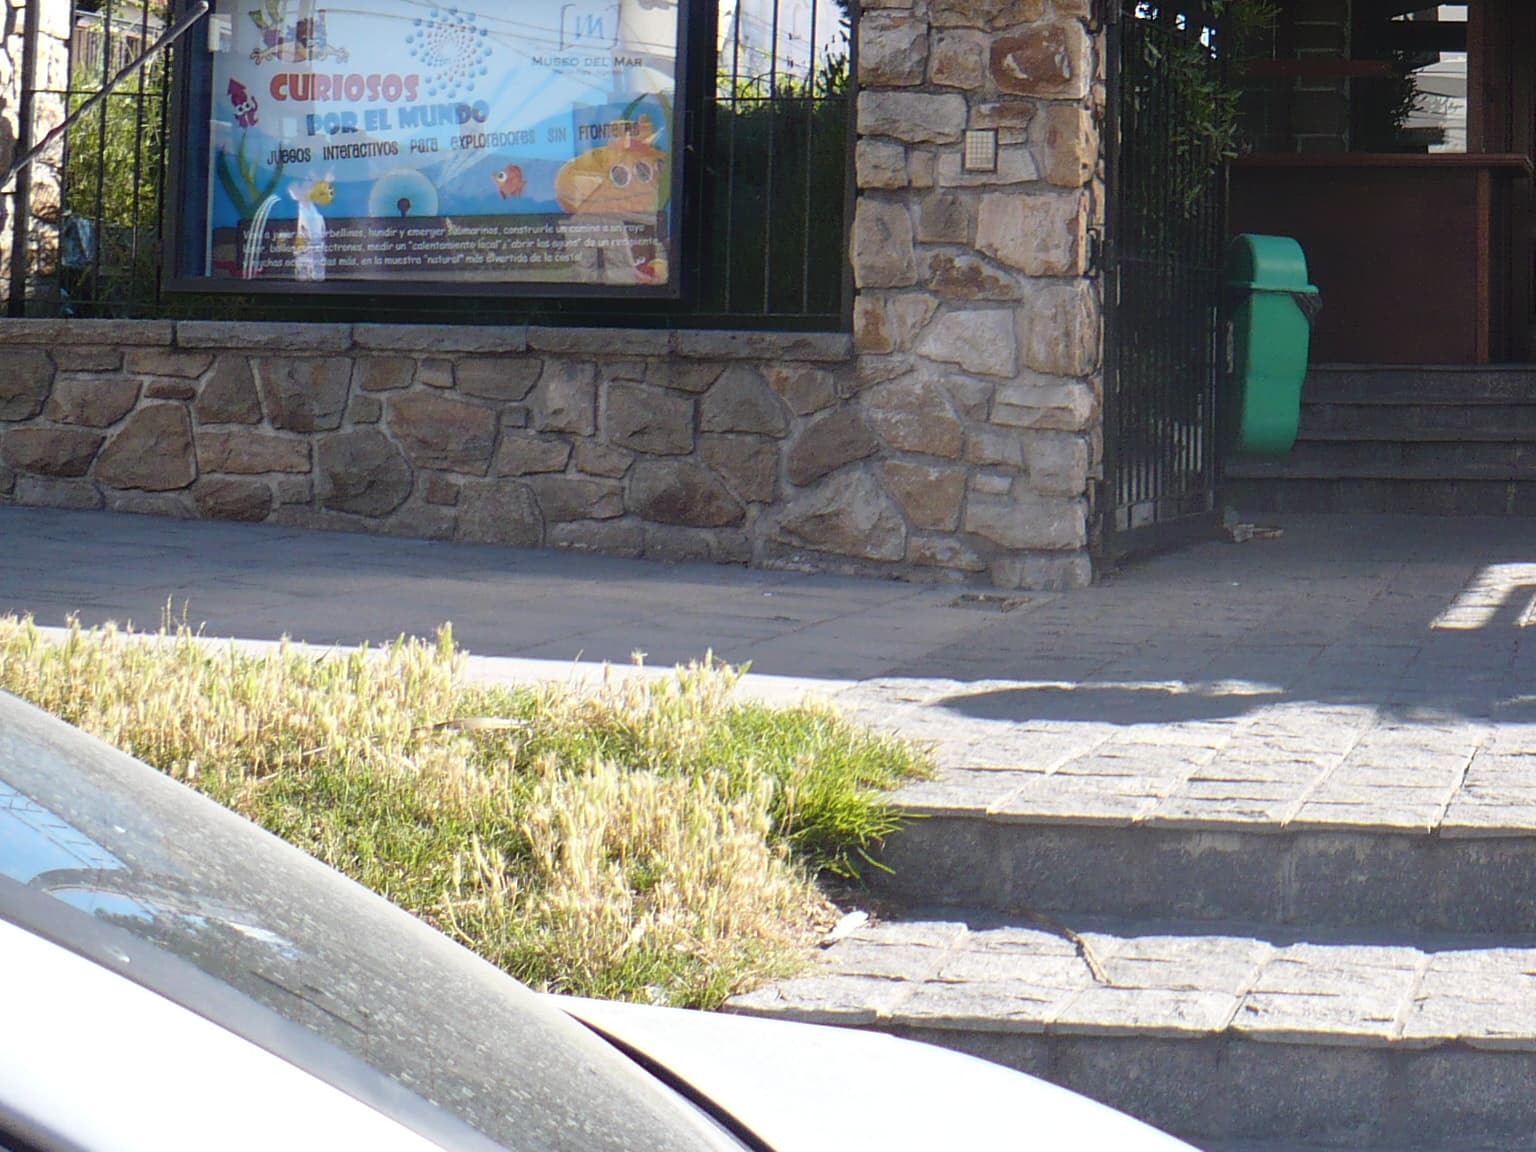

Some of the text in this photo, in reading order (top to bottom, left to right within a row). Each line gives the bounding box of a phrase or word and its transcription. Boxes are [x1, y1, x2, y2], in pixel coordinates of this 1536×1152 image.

[532, 56, 642, 67] MUSEO DEL MAR
[270, 73, 419, 102] CURIOSOS
[306, 99, 490, 136] POR EL MUNDO
[547, 127, 566, 143] SIN
